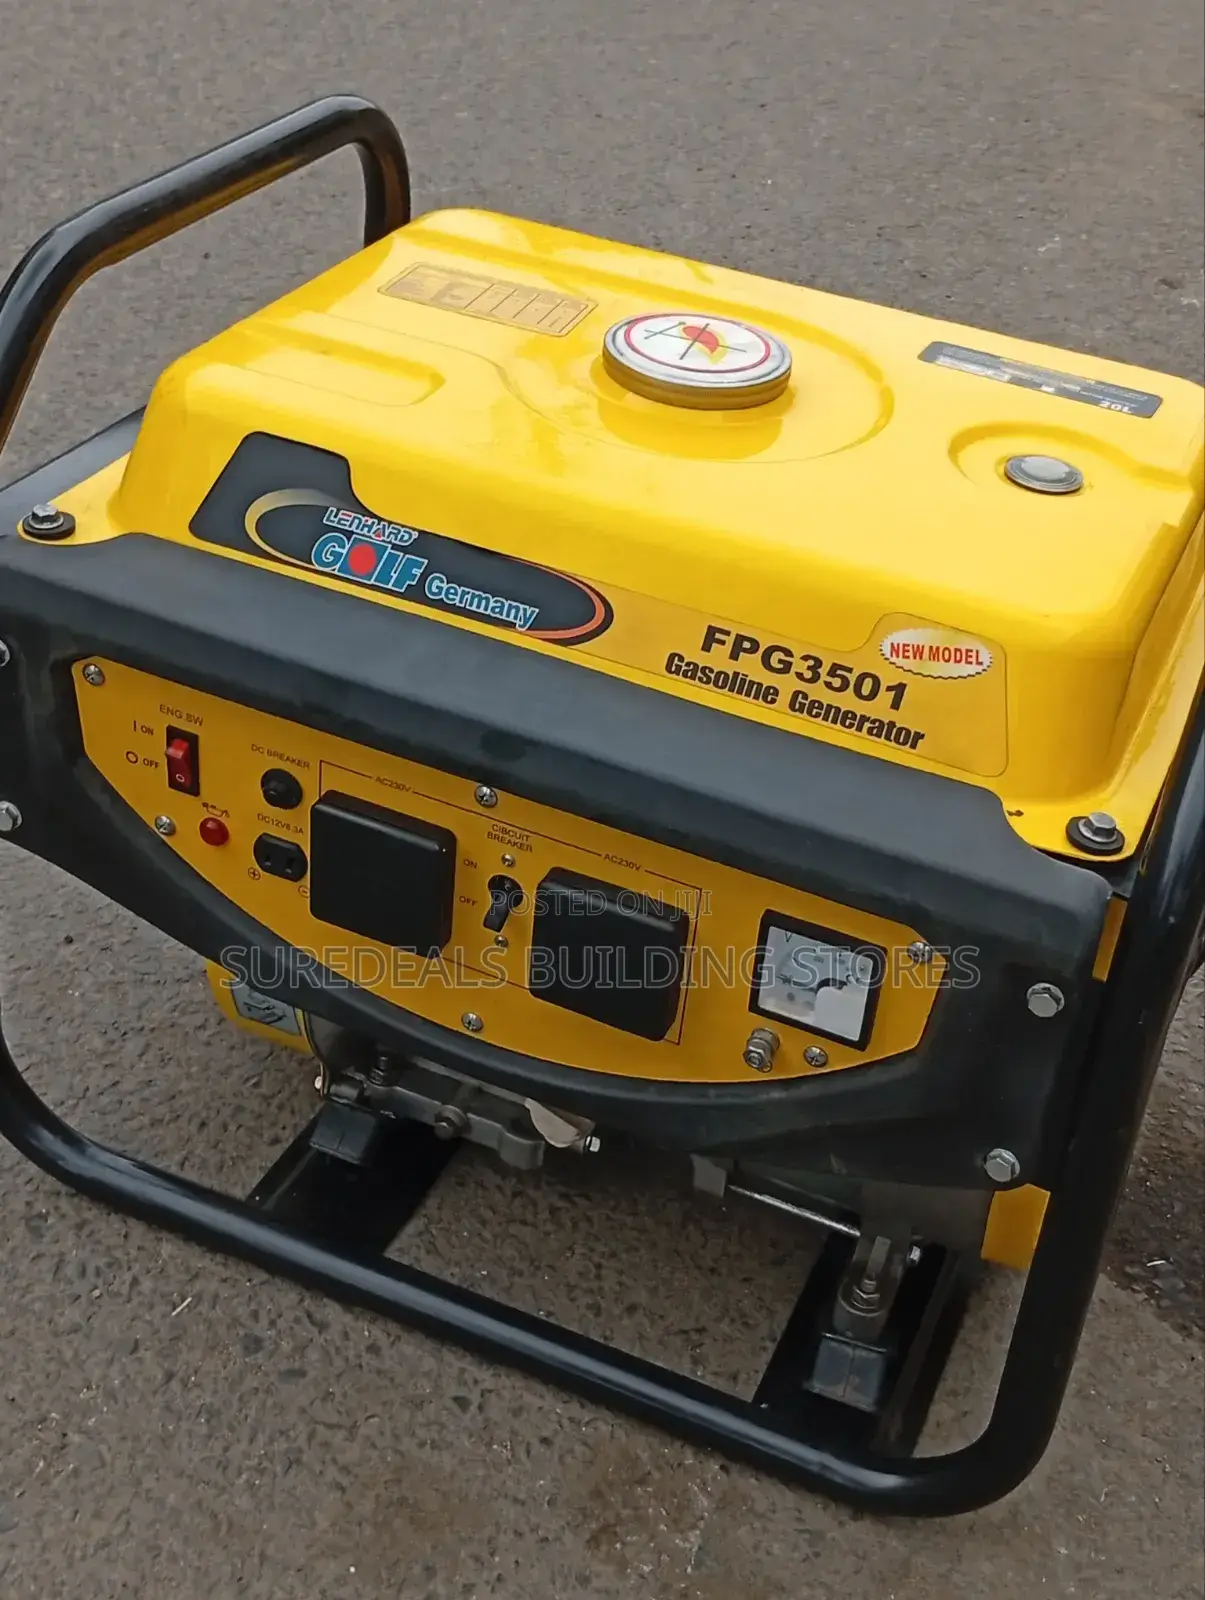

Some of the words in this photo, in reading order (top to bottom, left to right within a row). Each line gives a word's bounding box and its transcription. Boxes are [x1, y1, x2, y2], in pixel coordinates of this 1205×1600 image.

[311, 532, 428, 592] GOLF
[424, 572, 539, 631] Germany
[889, 641, 927, 661] NEW
[928, 644, 984, 667] MODEL
[700, 624, 908, 712] FPG3501
[665, 651, 780, 705] Gasoline
[788, 690, 925, 750] Generator
[140, 725, 154, 736] ON
[142, 758, 160, 769] OFF
[251, 743, 264, 755] DC
[266, 748, 311, 770] BREAKER
[375, 776, 412, 793] AC230V
[486, 831, 533, 853] BREAKER
[463, 858, 478, 869] ON
[604, 853, 642, 872] AC230V
[458, 895, 478, 907] OFF
